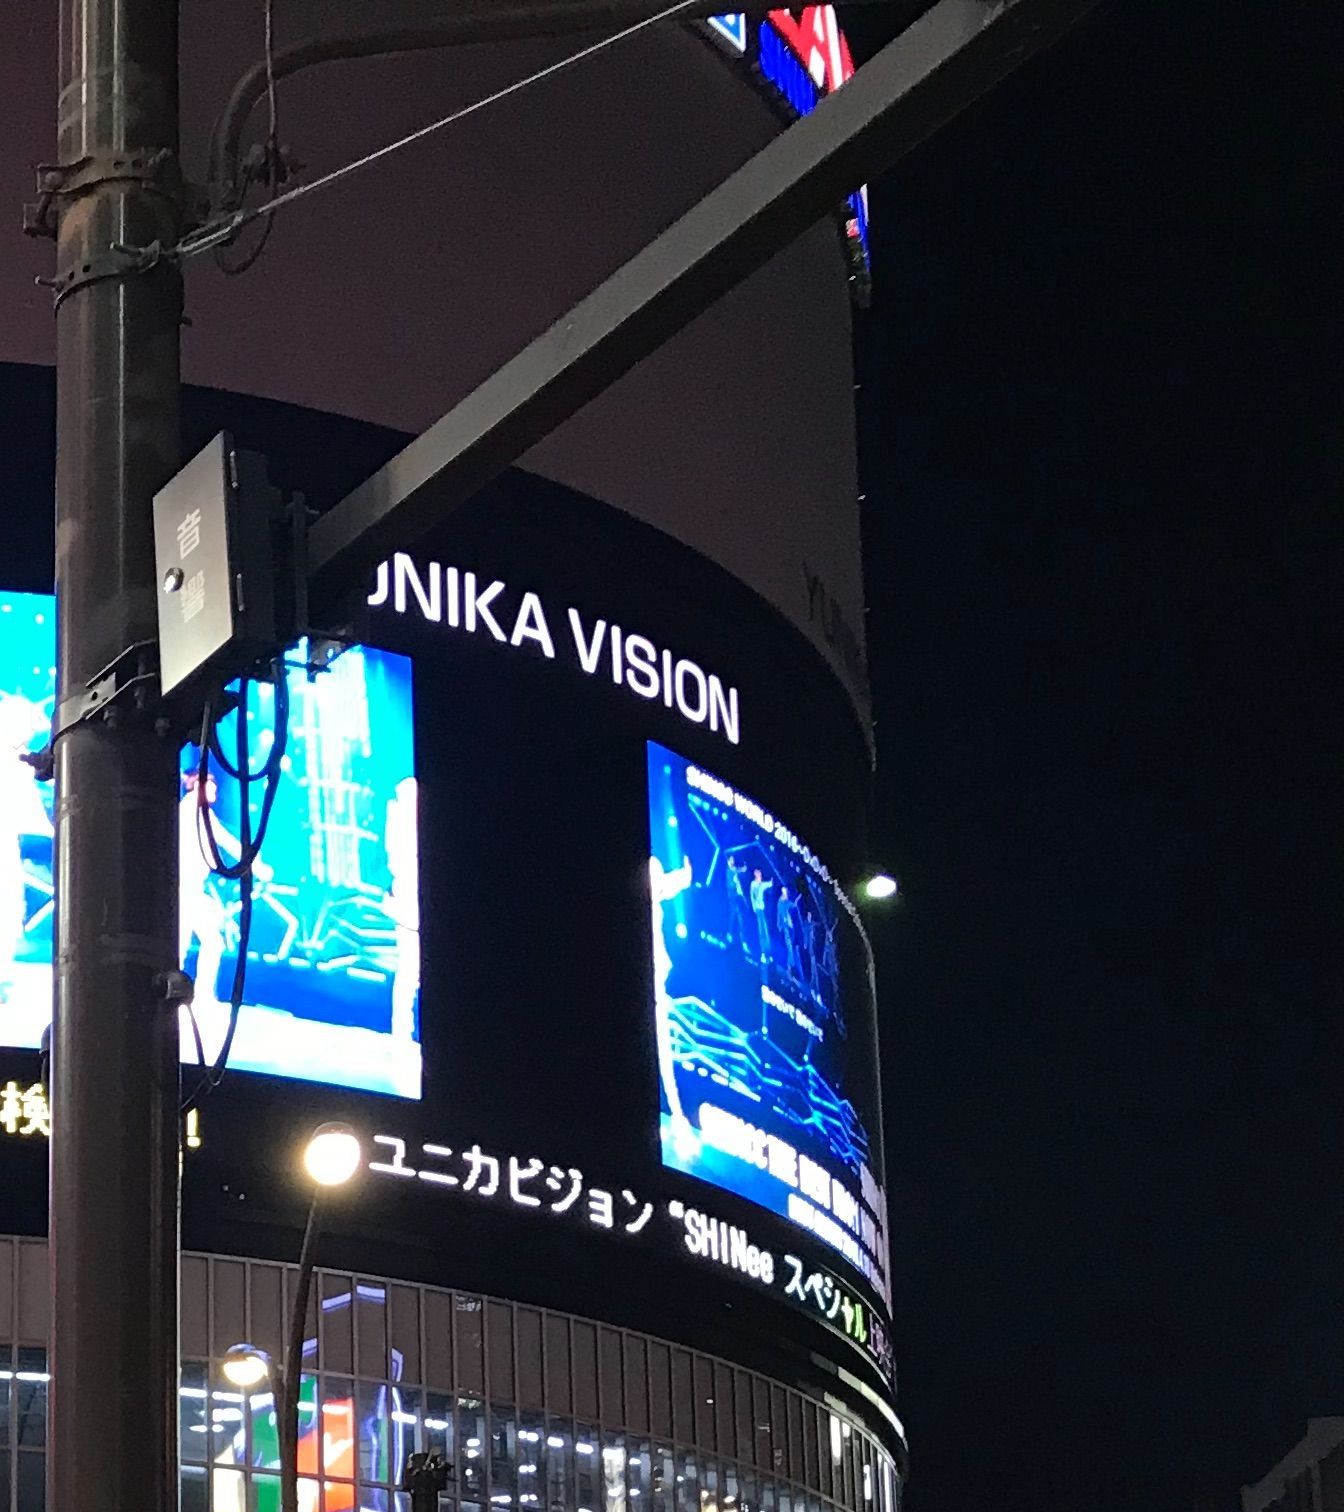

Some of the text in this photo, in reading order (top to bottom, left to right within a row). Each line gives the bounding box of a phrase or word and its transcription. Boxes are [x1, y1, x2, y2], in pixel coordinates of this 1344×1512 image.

[569, 608, 740, 744] VISION
[368, 1134, 655, 1233] ユニカビジョン
